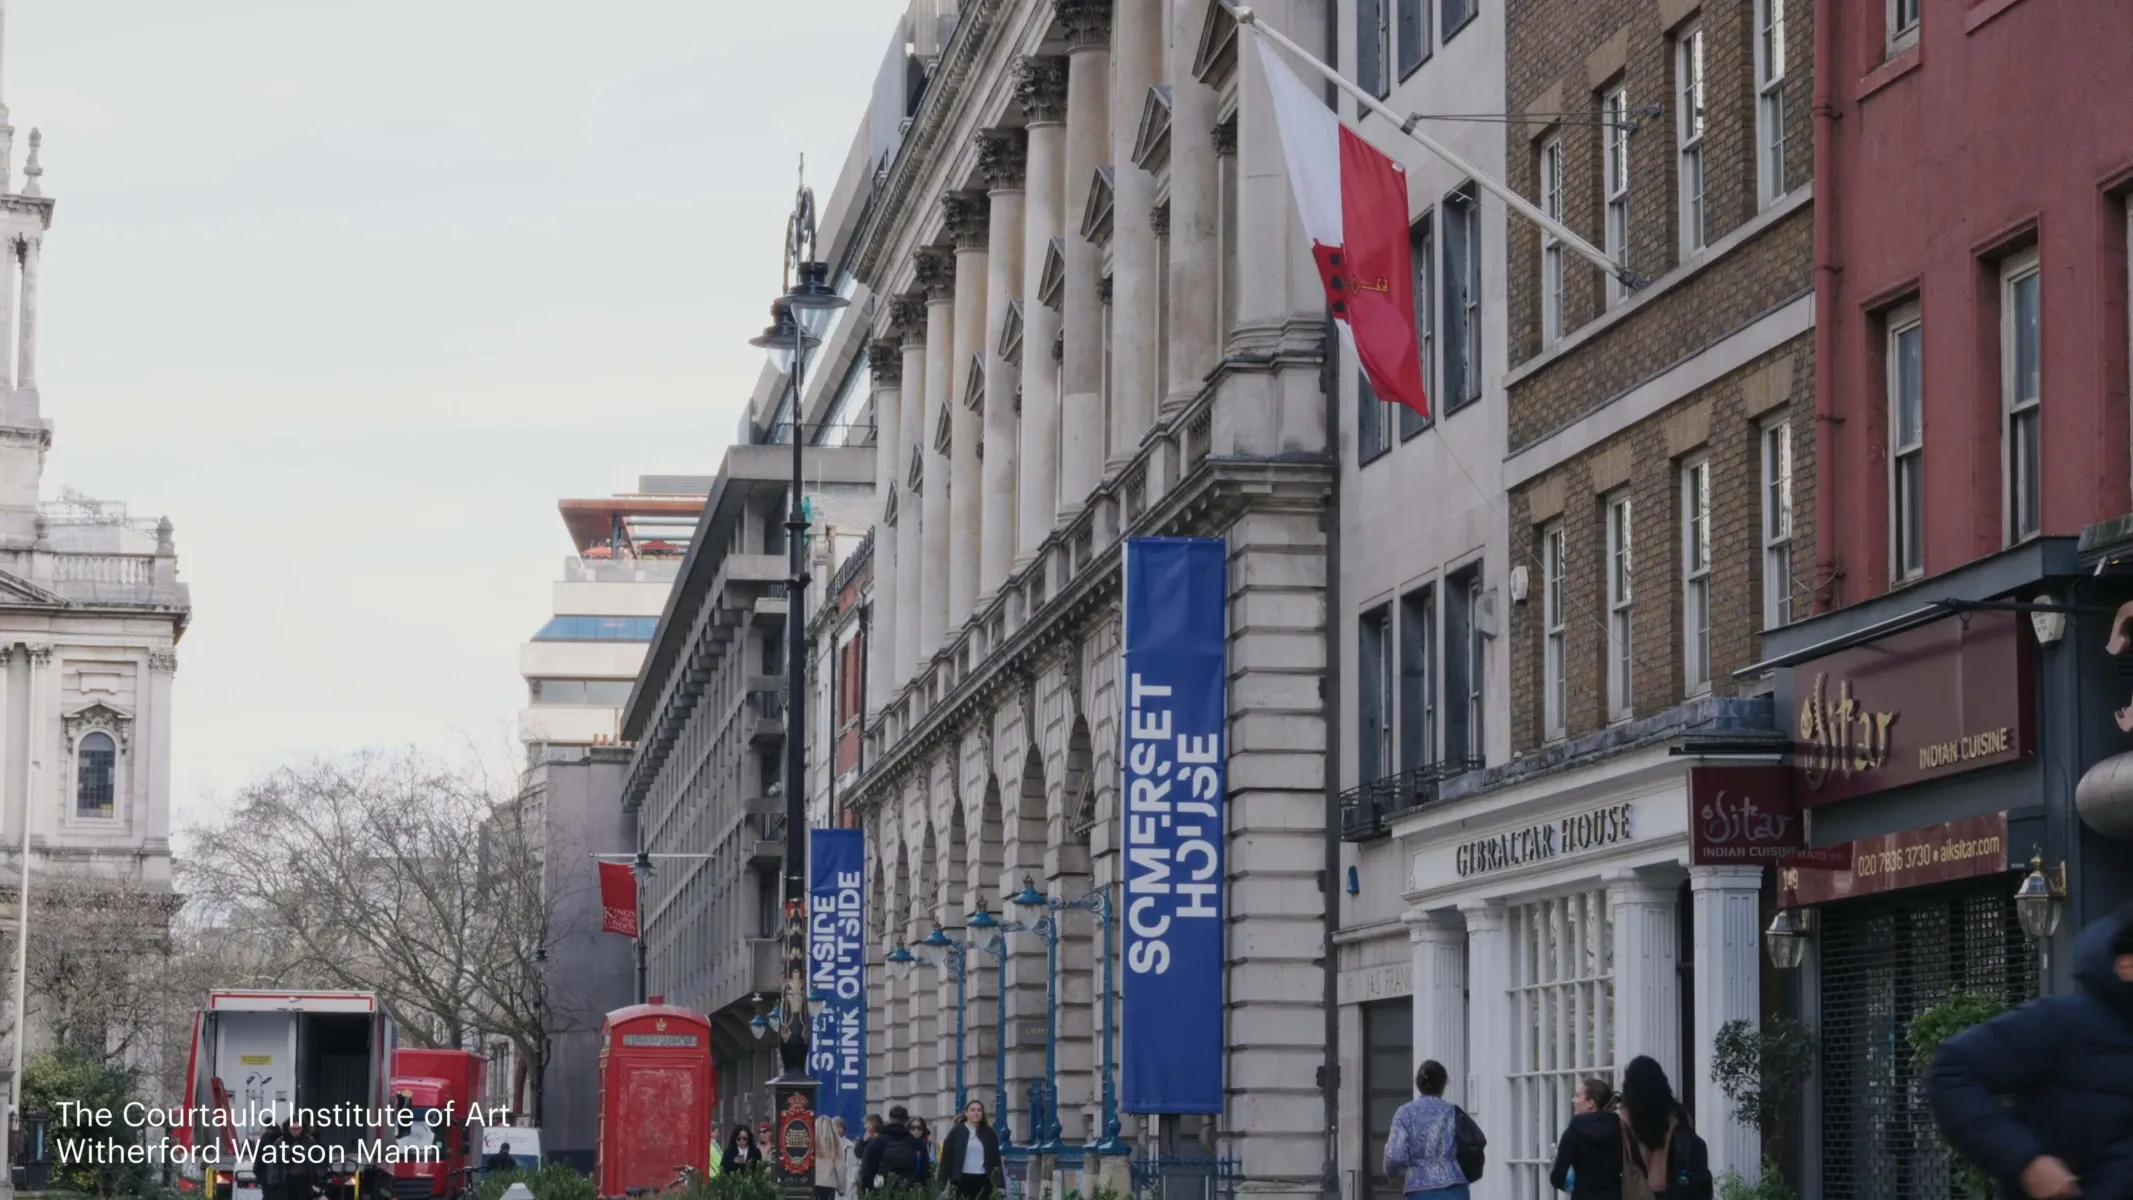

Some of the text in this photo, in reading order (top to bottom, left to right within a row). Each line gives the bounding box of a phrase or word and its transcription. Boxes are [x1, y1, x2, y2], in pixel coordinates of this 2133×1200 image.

[1919, 727, 2008, 769] INDIAN CUISINE
[1128, 673, 1172, 974] SOMERSET
[1176, 734, 1218, 917] HOUSE
[1456, 802, 1634, 877] GIBRALTAR HOUSE
[1703, 847, 1746, 857] INDIAN
[1858, 855, 1877, 877] 020
[1879, 849, 1903, 873] 7836
[1905, 844, 1931, 869] 3730
[812, 896, 836, 990] INSIDE
[837, 872, 860, 1000] OUTSIDE
